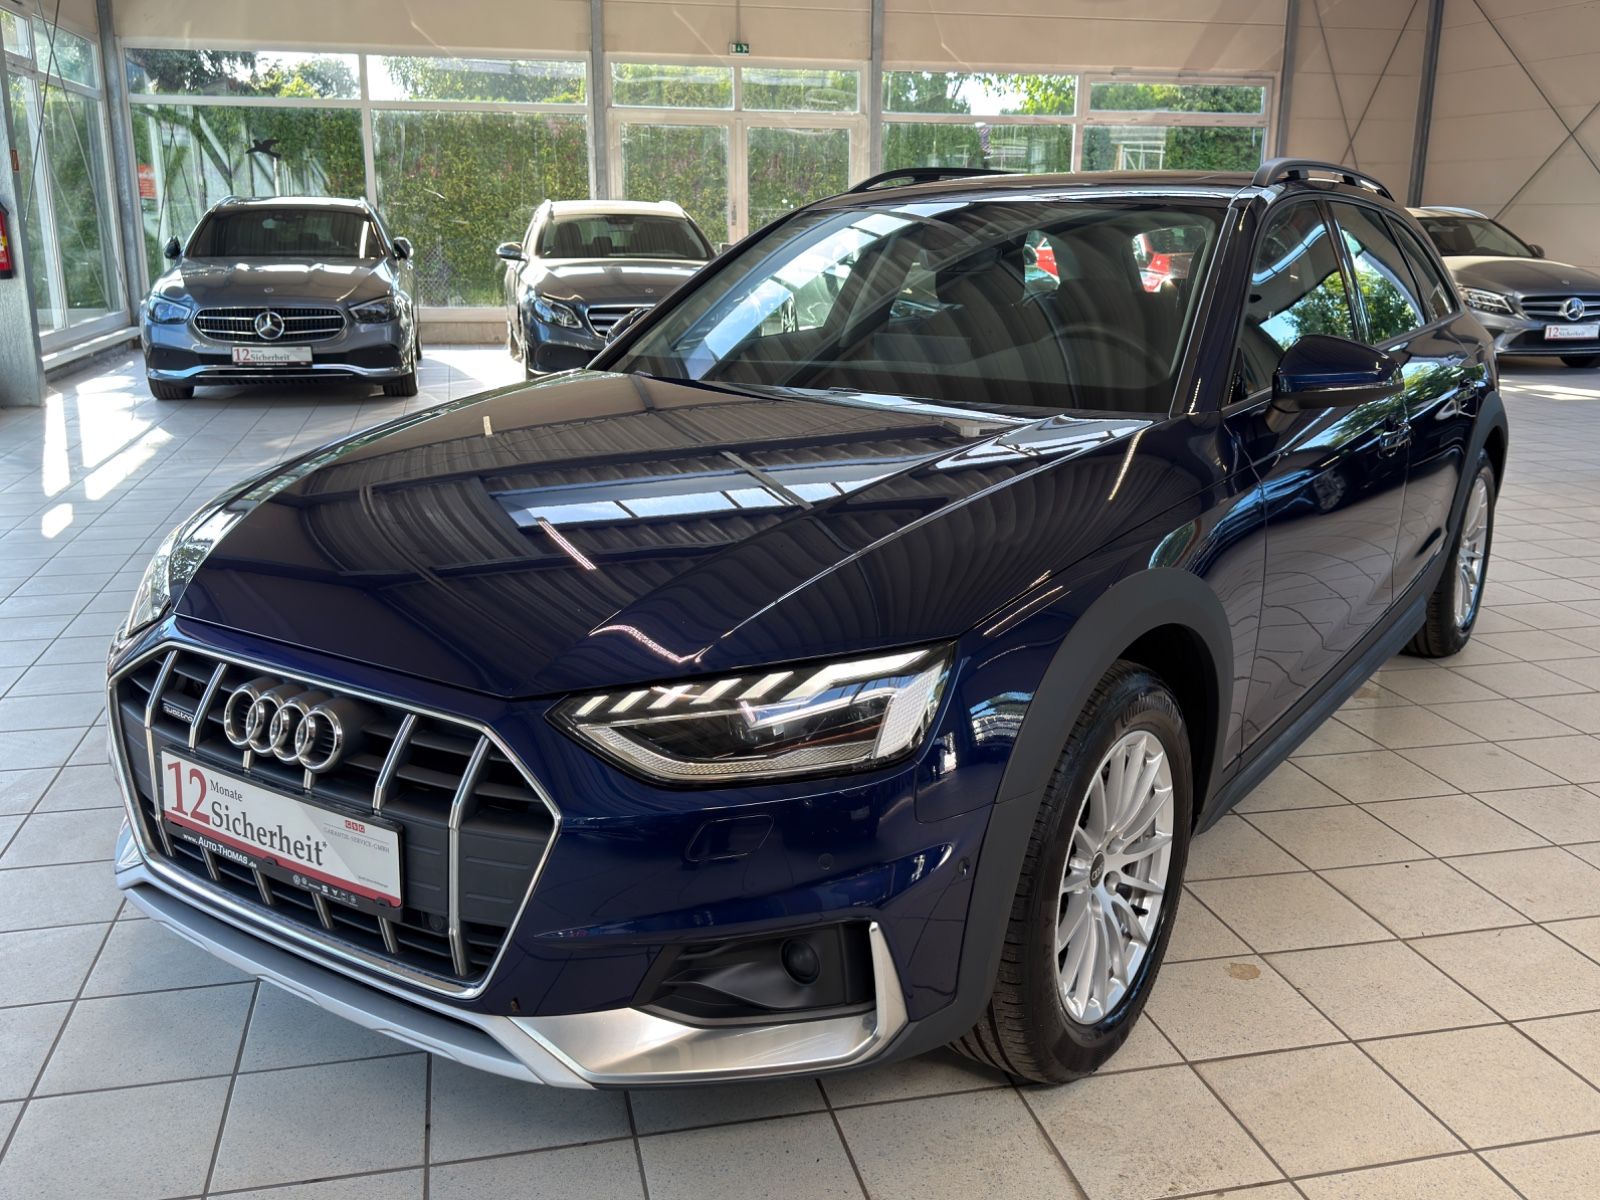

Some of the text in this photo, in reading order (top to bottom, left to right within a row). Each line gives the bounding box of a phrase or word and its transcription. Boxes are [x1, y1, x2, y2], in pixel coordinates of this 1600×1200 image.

[234, 348, 251, 361] 12
[167, 761, 210, 825] 12
[210, 779, 243, 802] Monate
